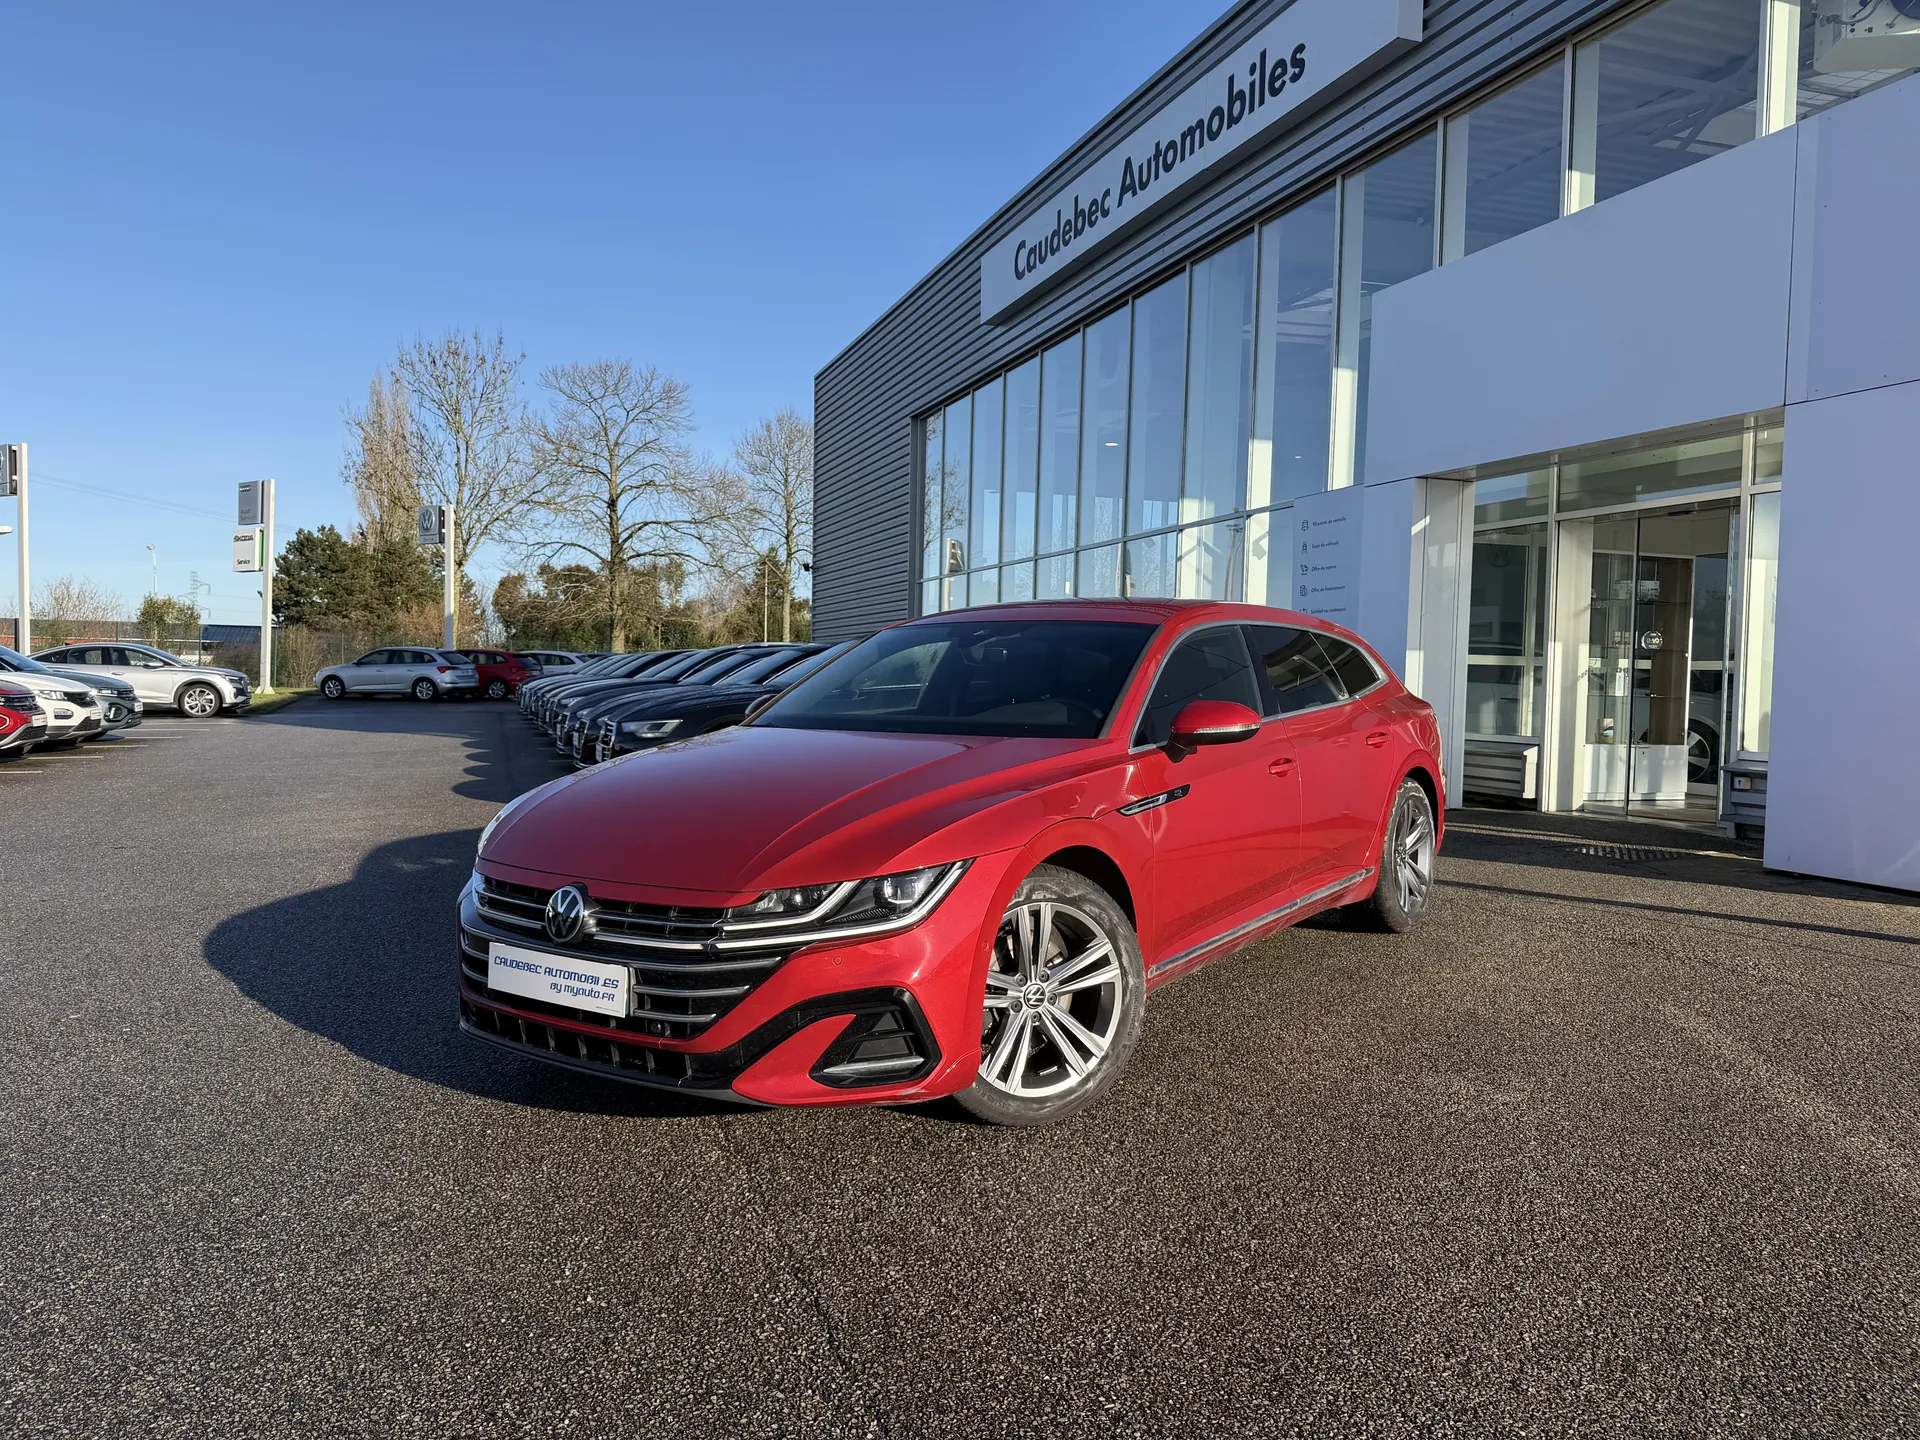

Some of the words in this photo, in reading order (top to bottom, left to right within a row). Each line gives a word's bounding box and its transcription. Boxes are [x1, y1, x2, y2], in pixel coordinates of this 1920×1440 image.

[1013, 187, 1111, 281] Caudebec
[1116, 42, 1307, 209] Automobiles
[493, 955, 543, 975] CAUDEBEC
[543, 966, 620, 989] AUTOMOBILES
